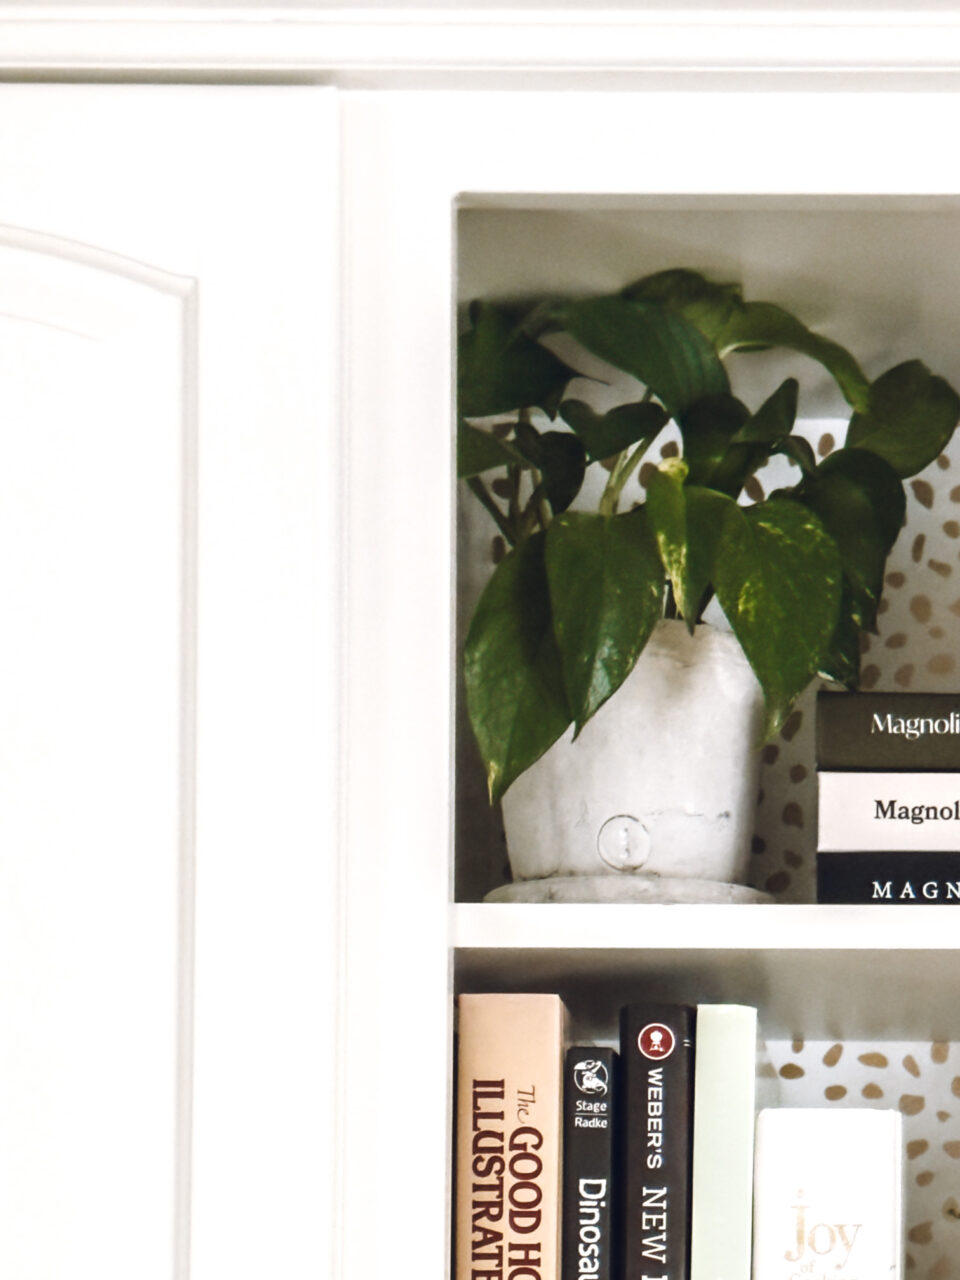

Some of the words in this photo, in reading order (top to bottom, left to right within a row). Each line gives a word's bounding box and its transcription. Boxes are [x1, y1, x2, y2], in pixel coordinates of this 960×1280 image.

[516, 1085, 537, 1125] The
[574, 1116, 608, 1129] Radke
[575, 1100, 608, 1113] Stage
[646, 1067, 664, 1169] WEBER'S
[508, 1127, 544, 1236] GOOD
[641, 1186, 668, 1264] NEW
[800, 1260, 816, 1274] of
